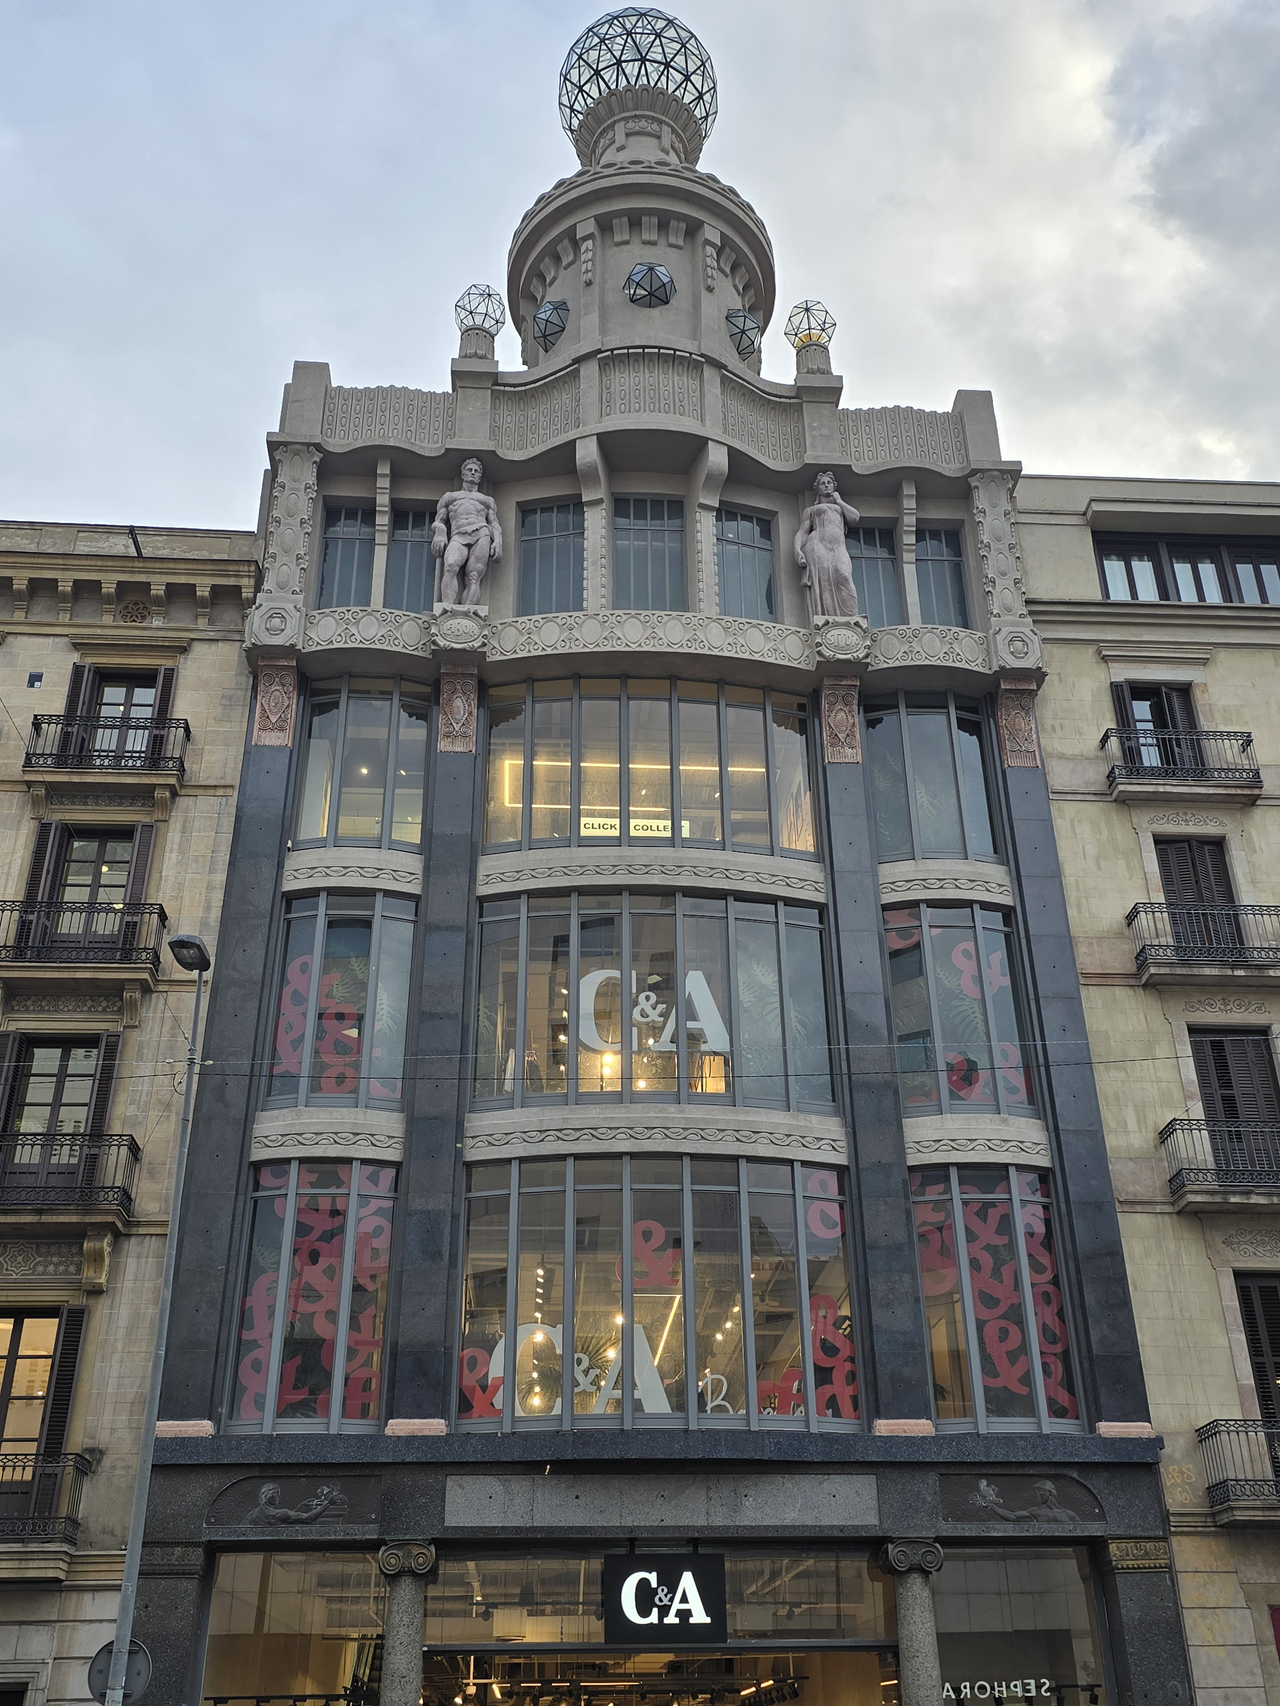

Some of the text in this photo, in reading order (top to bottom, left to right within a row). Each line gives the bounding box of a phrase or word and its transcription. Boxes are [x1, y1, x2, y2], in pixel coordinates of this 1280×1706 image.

[583, 822, 685, 833] CLICK COLLE
[579, 968, 731, 1052] C&A
[488, 1322, 673, 1417] C&A
[620, 1571, 712, 1625] C&A
